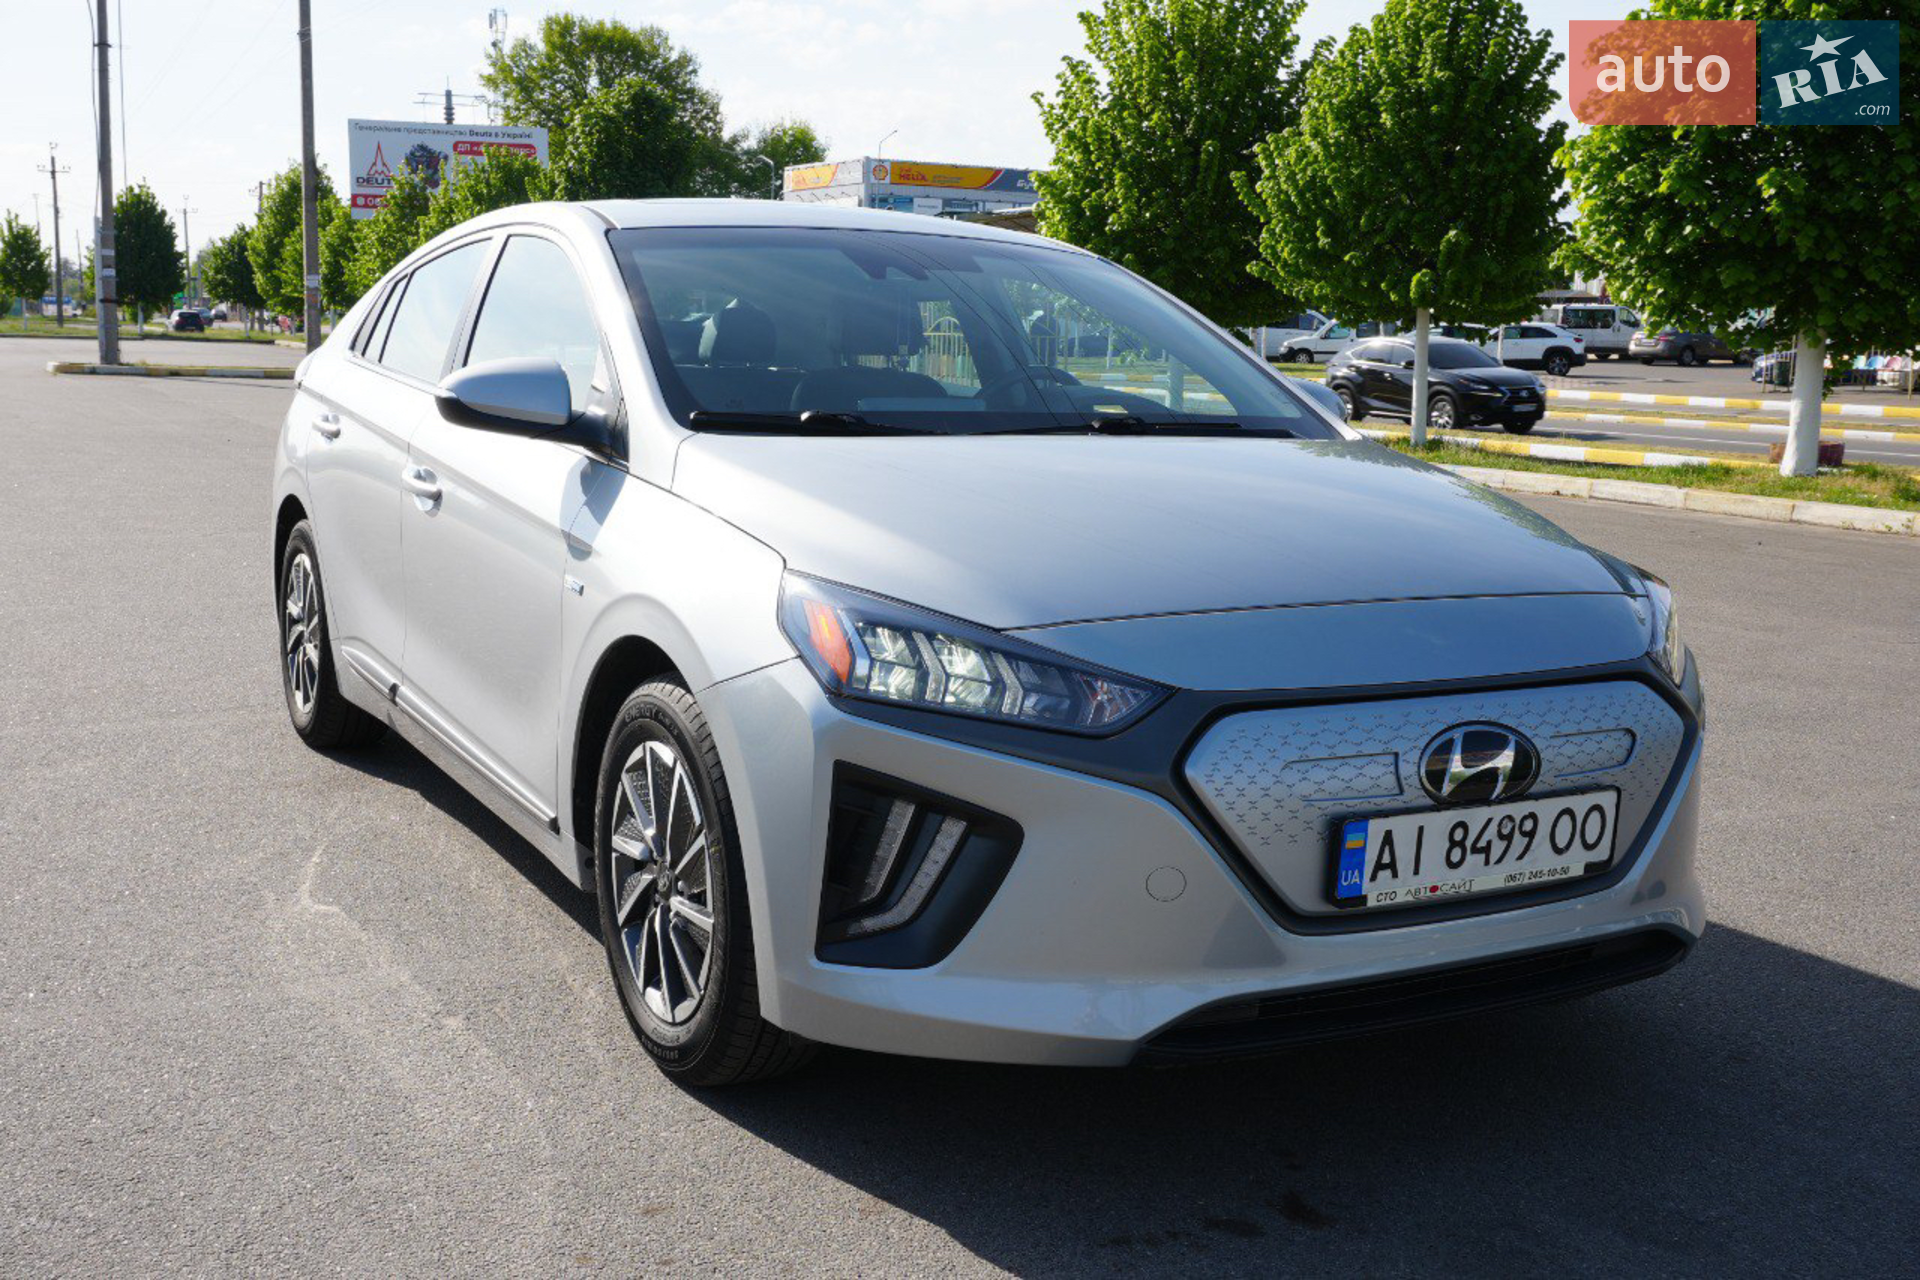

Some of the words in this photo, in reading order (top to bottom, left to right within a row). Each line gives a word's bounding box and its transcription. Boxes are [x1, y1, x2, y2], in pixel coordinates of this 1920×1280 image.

[469, 129, 493, 138] Deutz
[356, 176, 393, 185] DEUT
[1369, 825, 1424, 882] AI
[1445, 811, 1539, 870] 8499
[1549, 803, 1606, 856] OO
[1341, 869, 1360, 886] UA
[1376, 890, 1397, 903] СТО
